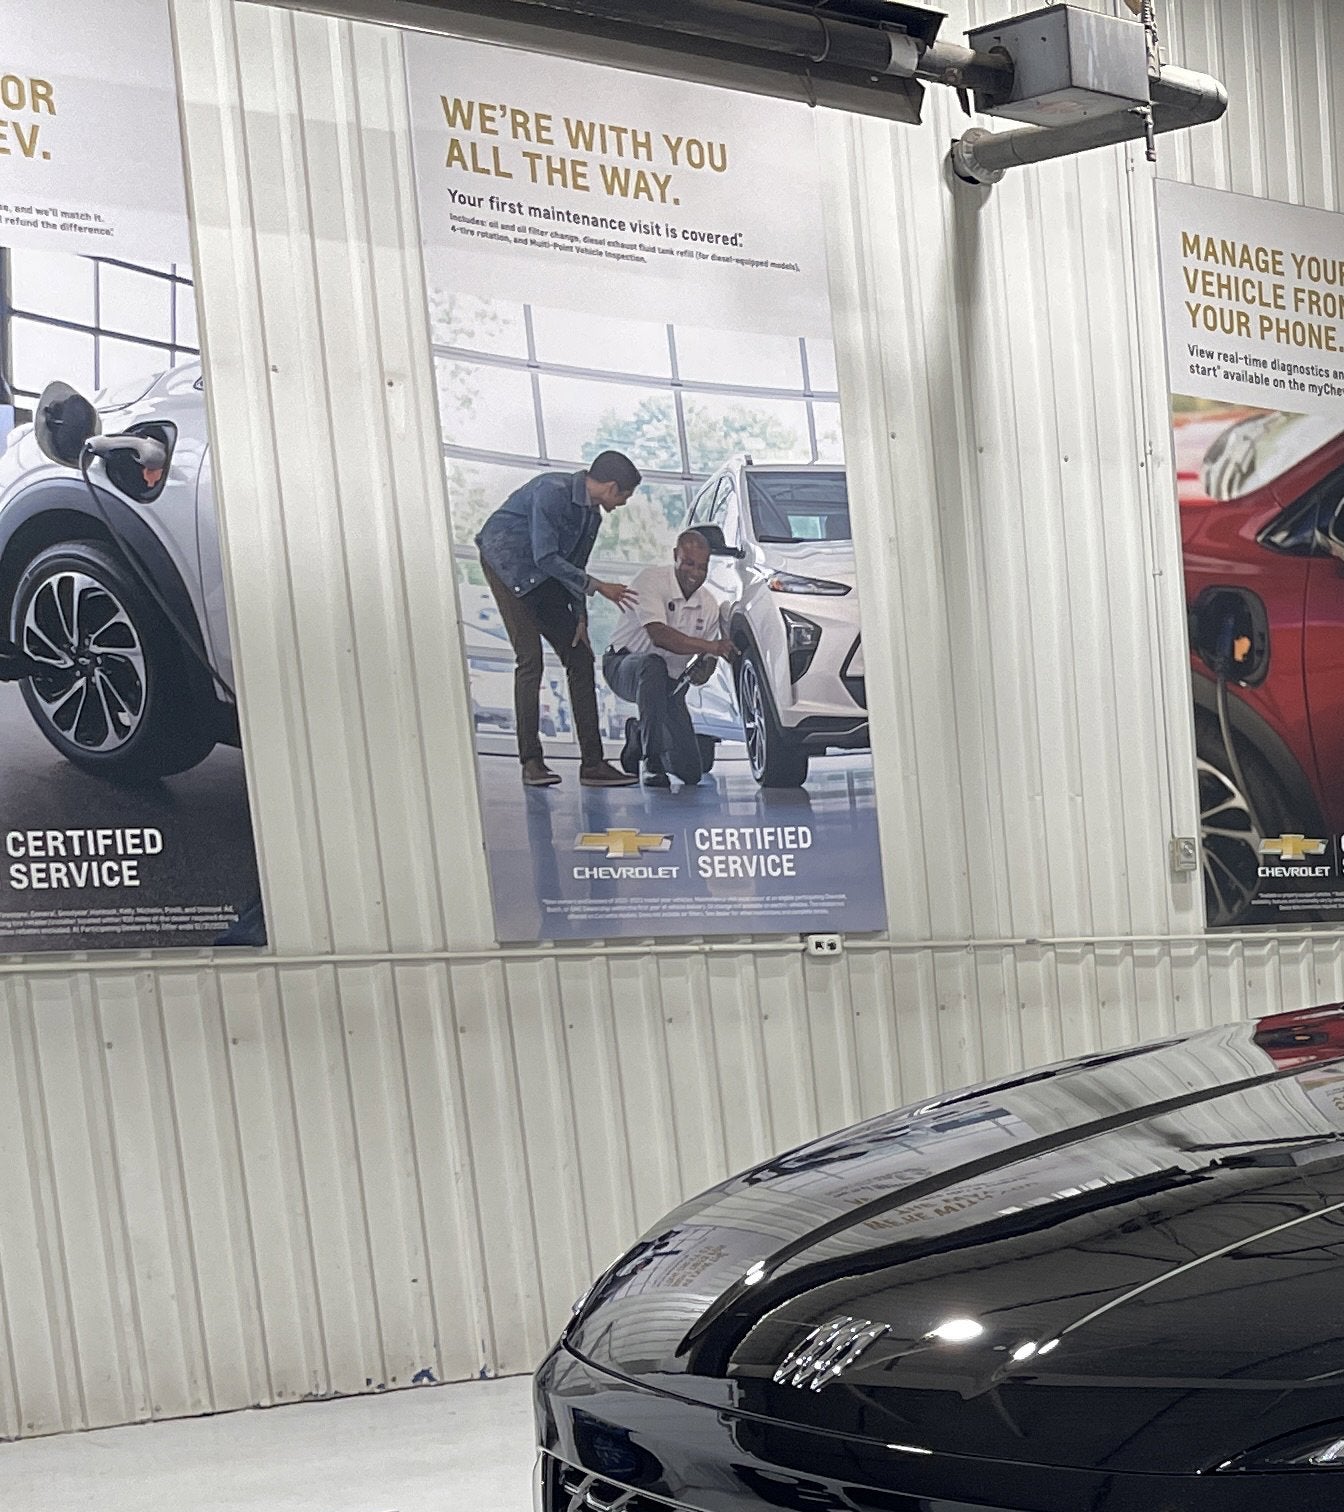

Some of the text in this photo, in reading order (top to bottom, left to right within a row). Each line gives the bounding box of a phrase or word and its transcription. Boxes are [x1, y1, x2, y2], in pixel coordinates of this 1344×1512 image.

[0, 74, 57, 116] OR
[440, 96, 728, 174] WE'RE WITH YOU
[445, 138, 682, 206] ALL THE WAY.
[5, 217, 39, 229] refund
[41, 220, 57, 230] the
[15, 205, 33, 214] and
[61, 210, 91, 222] match
[447, 188, 484, 209] Your
[489, 195, 524, 215] first
[528, 205, 626, 232] maintenance
[629, 219, 662, 237] visit
[665, 223, 678, 239] is
[1181, 231, 1285, 276] MANAGE
[1182, 266, 1286, 311] VEHICLE
[1185, 301, 1344, 352] YOUR PHONE.
[1188, 344, 1214, 360] View
[1217, 348, 1268, 370] real-time
[1270, 357, 1330, 380] diagnostics
[1223, 367, 1270, 386] available
[1273, 377, 1286, 389] on
[1288, 377, 1305, 392] the
[6, 828, 163, 858] CERTIFIED
[694, 826, 812, 850] CERTIFIED
[9, 860, 140, 889] SERVICE
[573, 866, 680, 879] CHEVROLET
[697, 854, 796, 878] SERVICE
[1257, 866, 1330, 877] CHEVROLET
